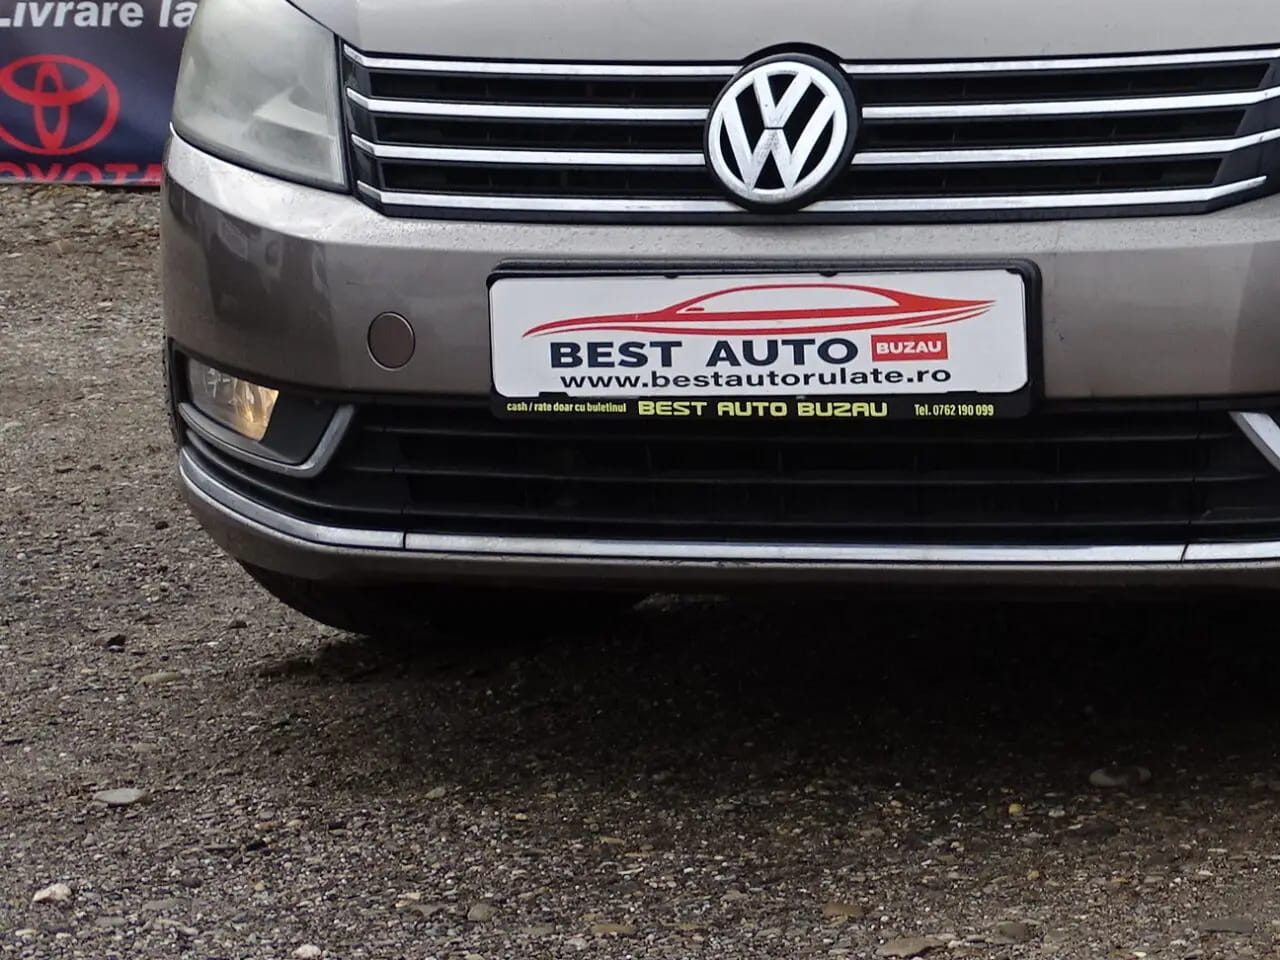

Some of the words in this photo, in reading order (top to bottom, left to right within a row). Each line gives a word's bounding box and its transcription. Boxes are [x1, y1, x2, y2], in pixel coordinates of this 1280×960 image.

[550, 340, 682, 369] BEST
[706, 338, 858, 368] AUTO
[876, 340, 942, 356] BUZAU
[560, 367, 952, 389] www.bestautorulate.ro
[506, 401, 528, 412] cash
[533, 402, 552, 413] rate
[553, 402, 573, 413] doar
[574, 404, 586, 413] cu
[586, 401, 627, 413] buletinul
[638, 400, 708, 416] BEST
[717, 401, 788, 417] AUTO
[797, 401, 888, 417] BUZAU
[914, 403, 932, 417] Tel.
[932, 403, 956, 417] 0762
[957, 404, 975, 416] 190
[975, 403, 994, 416] 099
